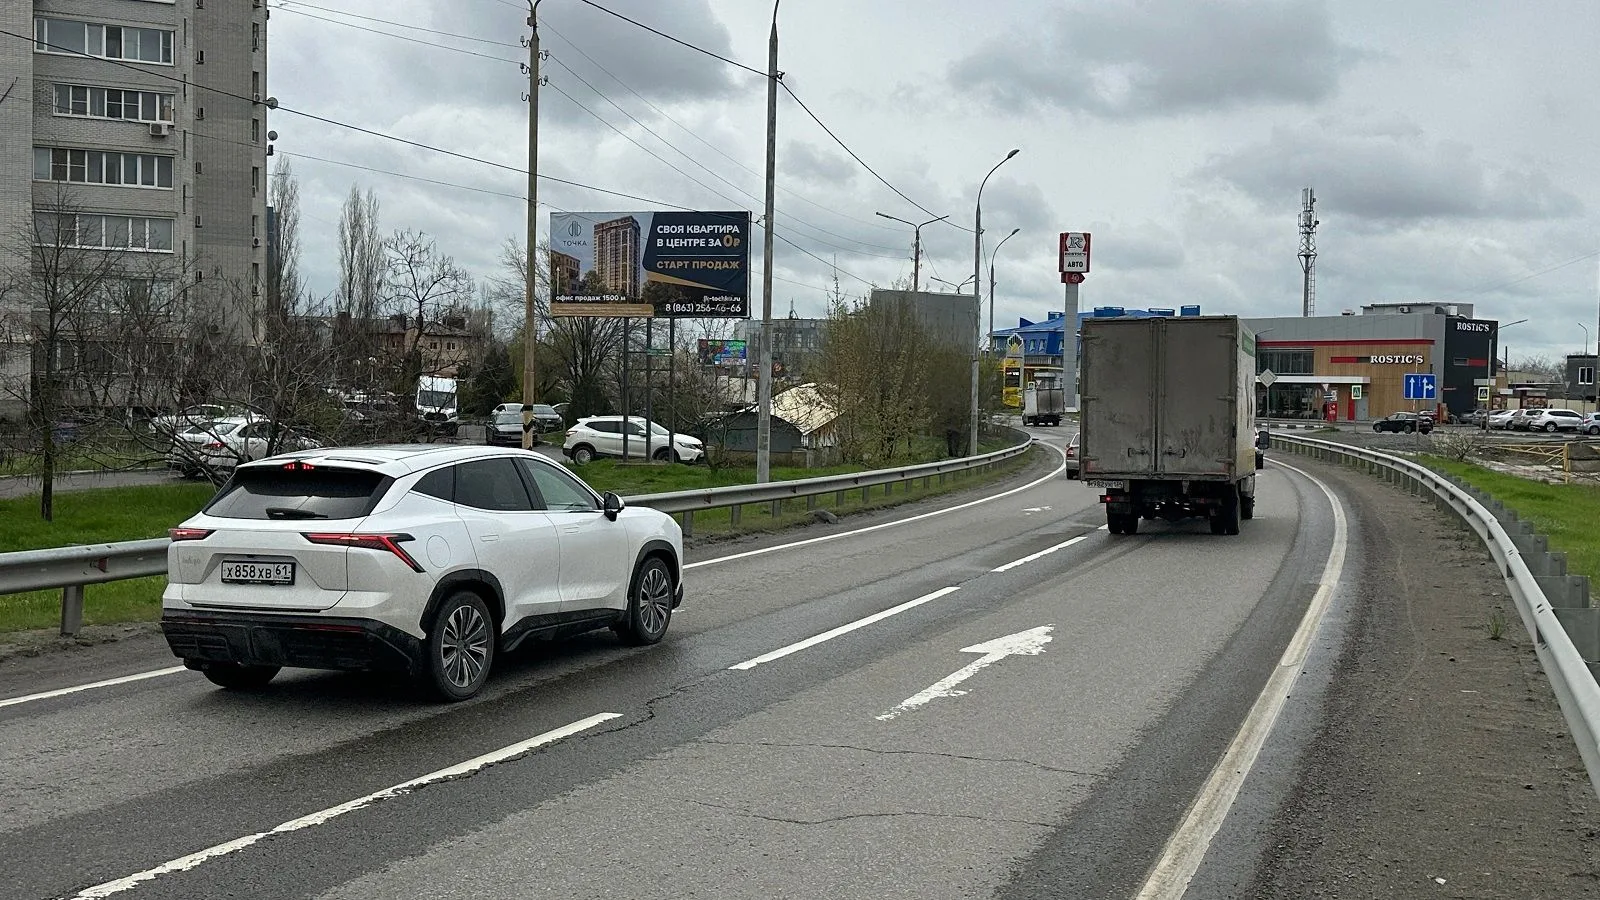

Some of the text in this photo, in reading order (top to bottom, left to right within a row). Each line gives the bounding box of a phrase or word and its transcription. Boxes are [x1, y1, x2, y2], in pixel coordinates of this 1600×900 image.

[656, 225, 740, 234] СВОЯ КВАРТИРА
[666, 239, 706, 248] ЦЕНТРЕ
[708, 239, 722, 247] ЗА
[656, 261, 739, 270] СТАРТ ПРОДАЖ
[556, 294, 574, 302] офис
[665, 304, 671, 312] 8
[673, 303, 694, 312] (863)
[1456, 322, 1490, 332] ROSTIC'S
[1370, 355, 1424, 364] ROSTIC'S
[275, 565, 288, 575] 61
